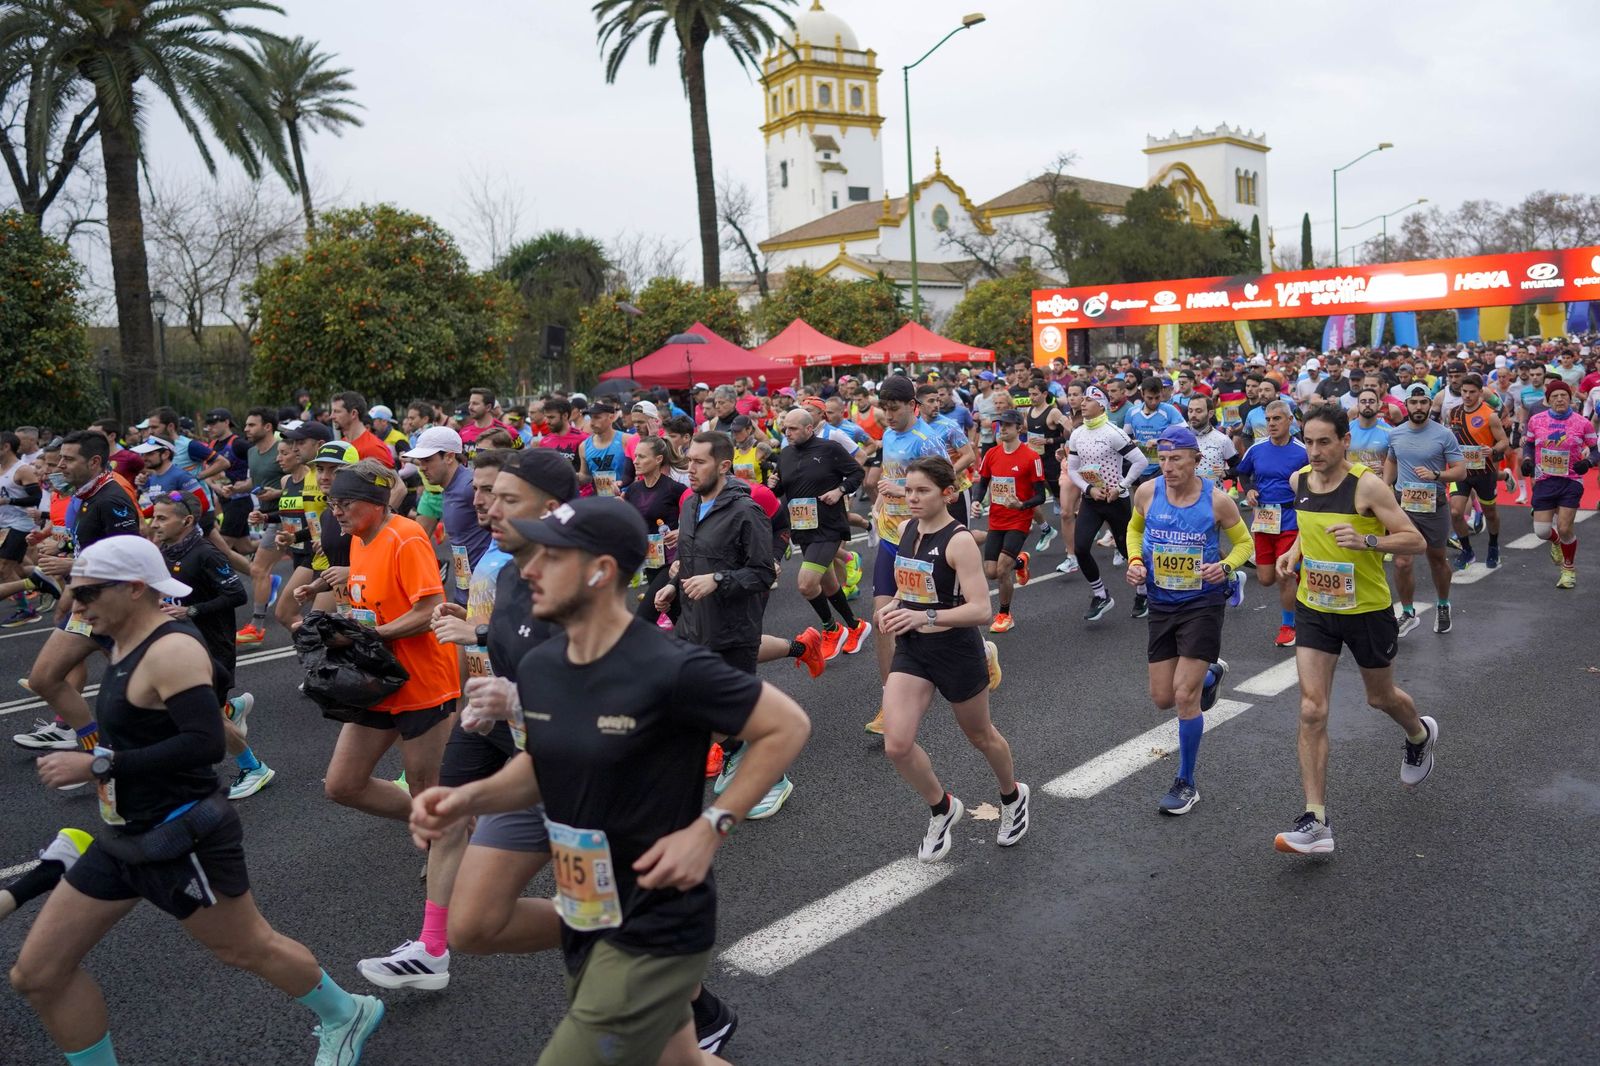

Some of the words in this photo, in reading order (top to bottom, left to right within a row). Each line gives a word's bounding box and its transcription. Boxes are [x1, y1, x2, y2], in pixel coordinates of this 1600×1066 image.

[1454, 270, 1511, 291] HOKA
[1156, 555, 1194, 571] 14973
[898, 569, 921, 589] 5767
[1309, 571, 1341, 590] 5298
